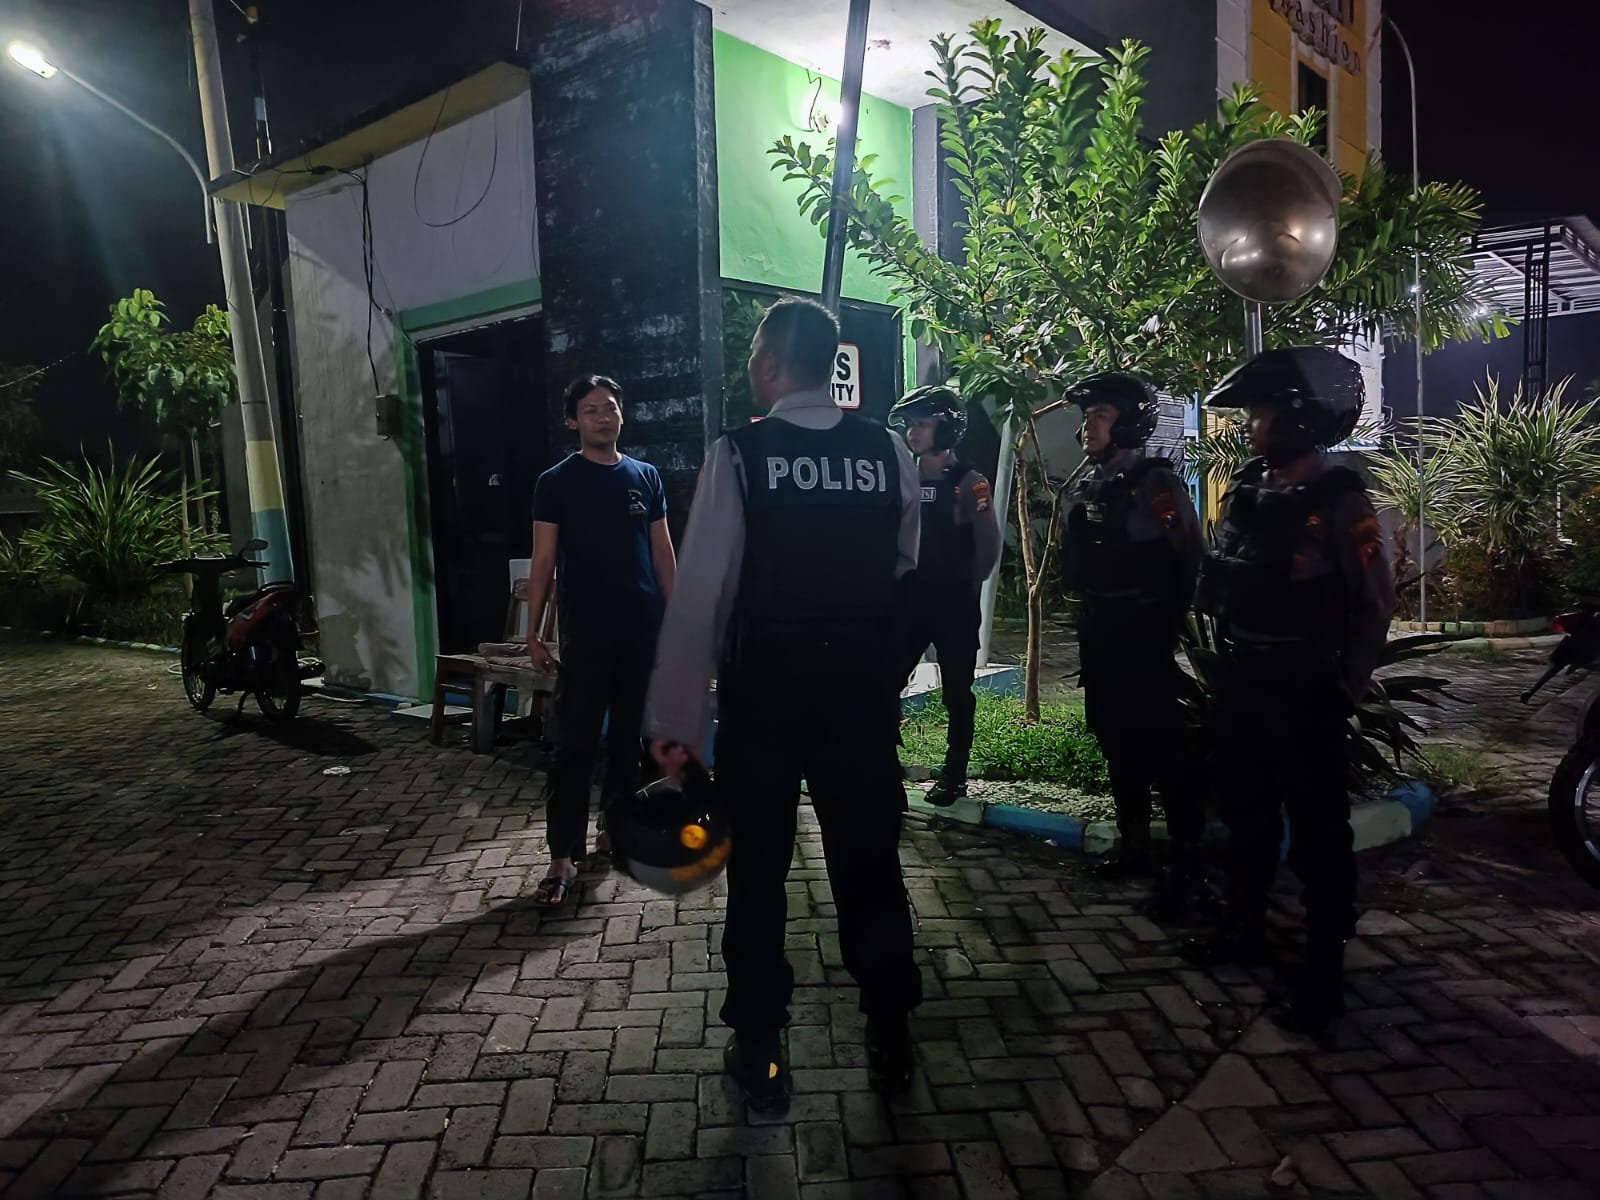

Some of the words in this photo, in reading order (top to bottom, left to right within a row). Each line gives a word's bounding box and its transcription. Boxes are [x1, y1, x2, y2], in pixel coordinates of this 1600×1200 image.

[836, 351, 851, 381] S
[831, 382, 854, 402] ITY
[766, 456, 886, 492] POLISI
